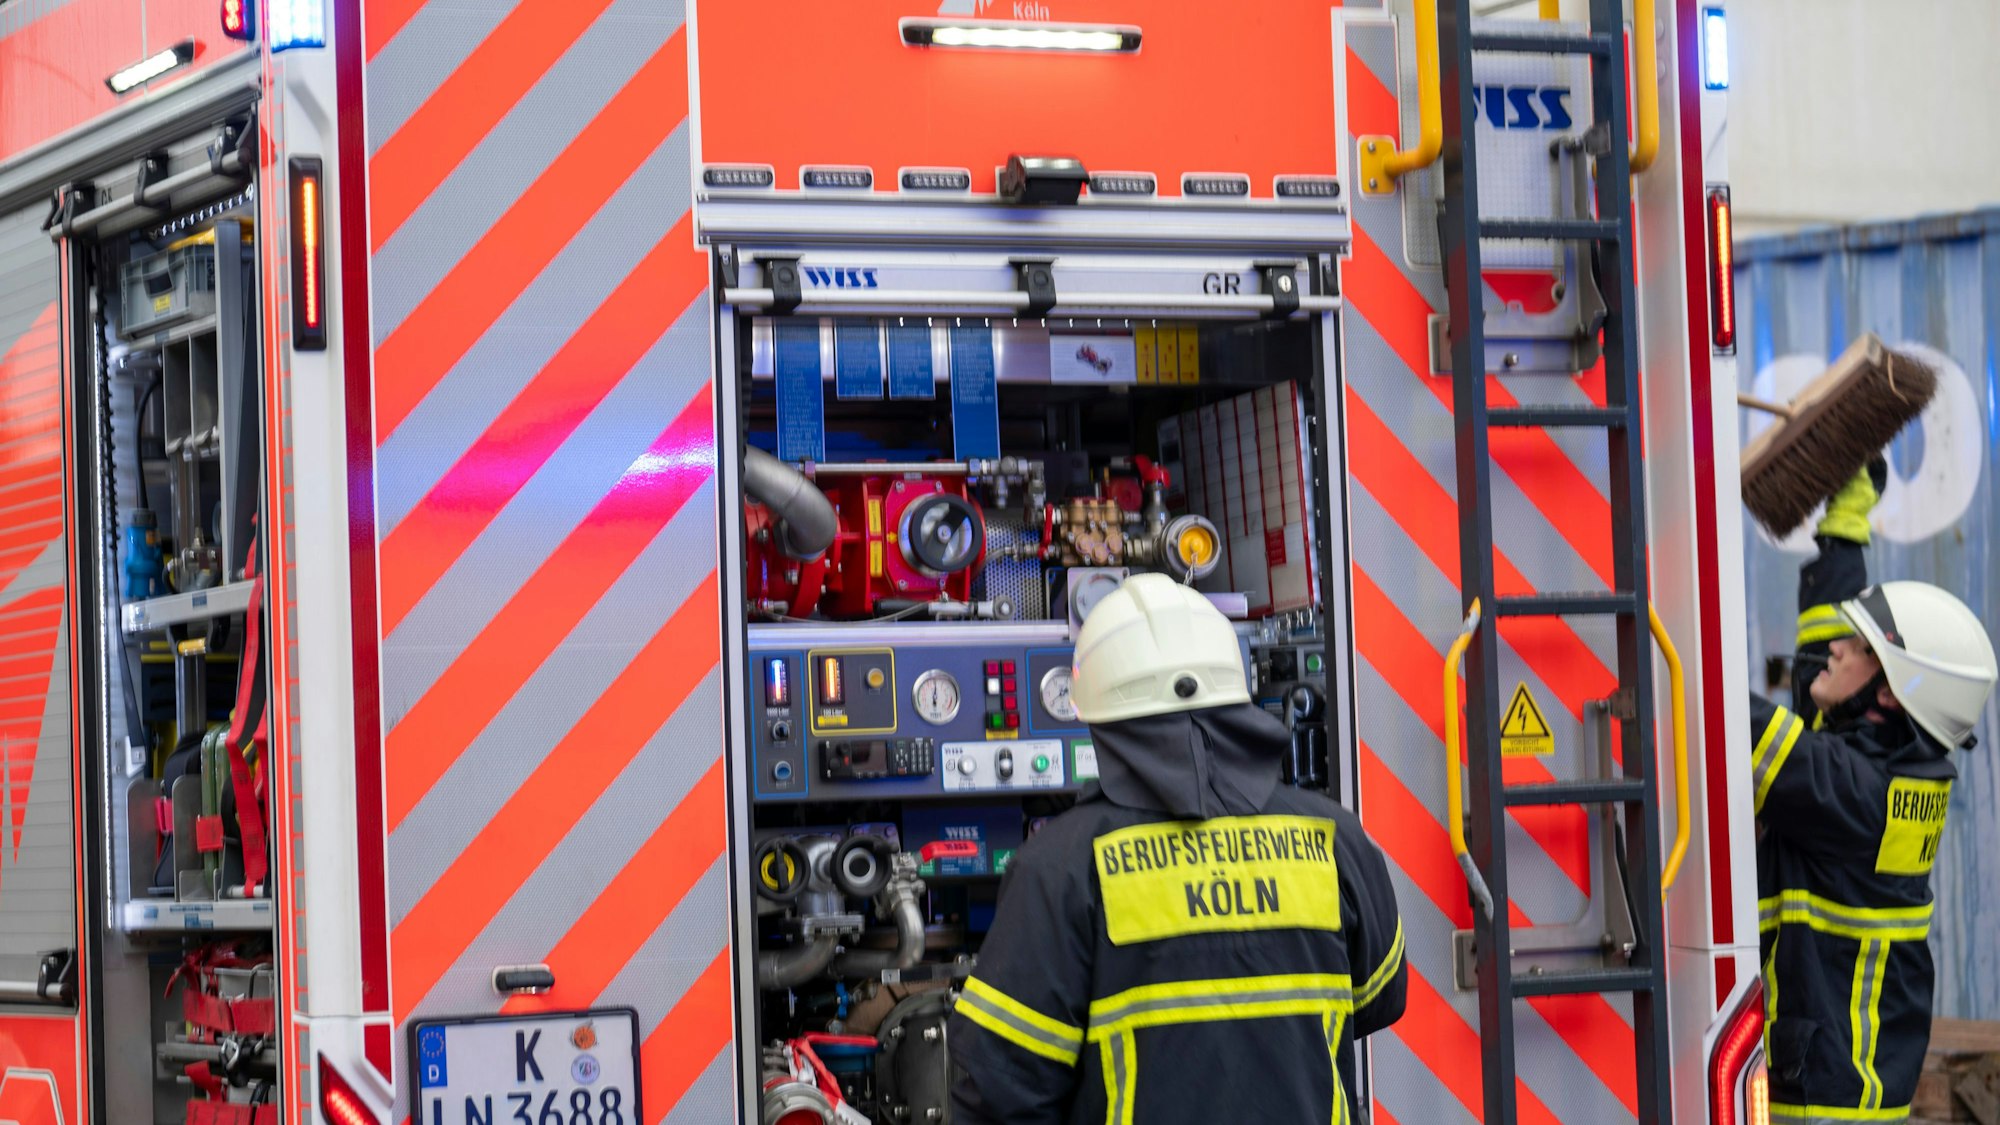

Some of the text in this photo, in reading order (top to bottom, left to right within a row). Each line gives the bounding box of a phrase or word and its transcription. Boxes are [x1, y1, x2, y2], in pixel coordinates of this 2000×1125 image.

[1013, 1, 1050, 21] Köln
[1473, 85, 1572, 129] ISS
[803, 267, 878, 289] WISS
[1203, 272, 1240, 295] GR
[945, 826, 978, 841] WISS
[1102, 827, 1329, 875] BERUFSFEUERWEHR
[1184, 870, 1280, 917] KÖLN
[515, 1029, 544, 1082] K
[428, 1065, 439, 1082] D
